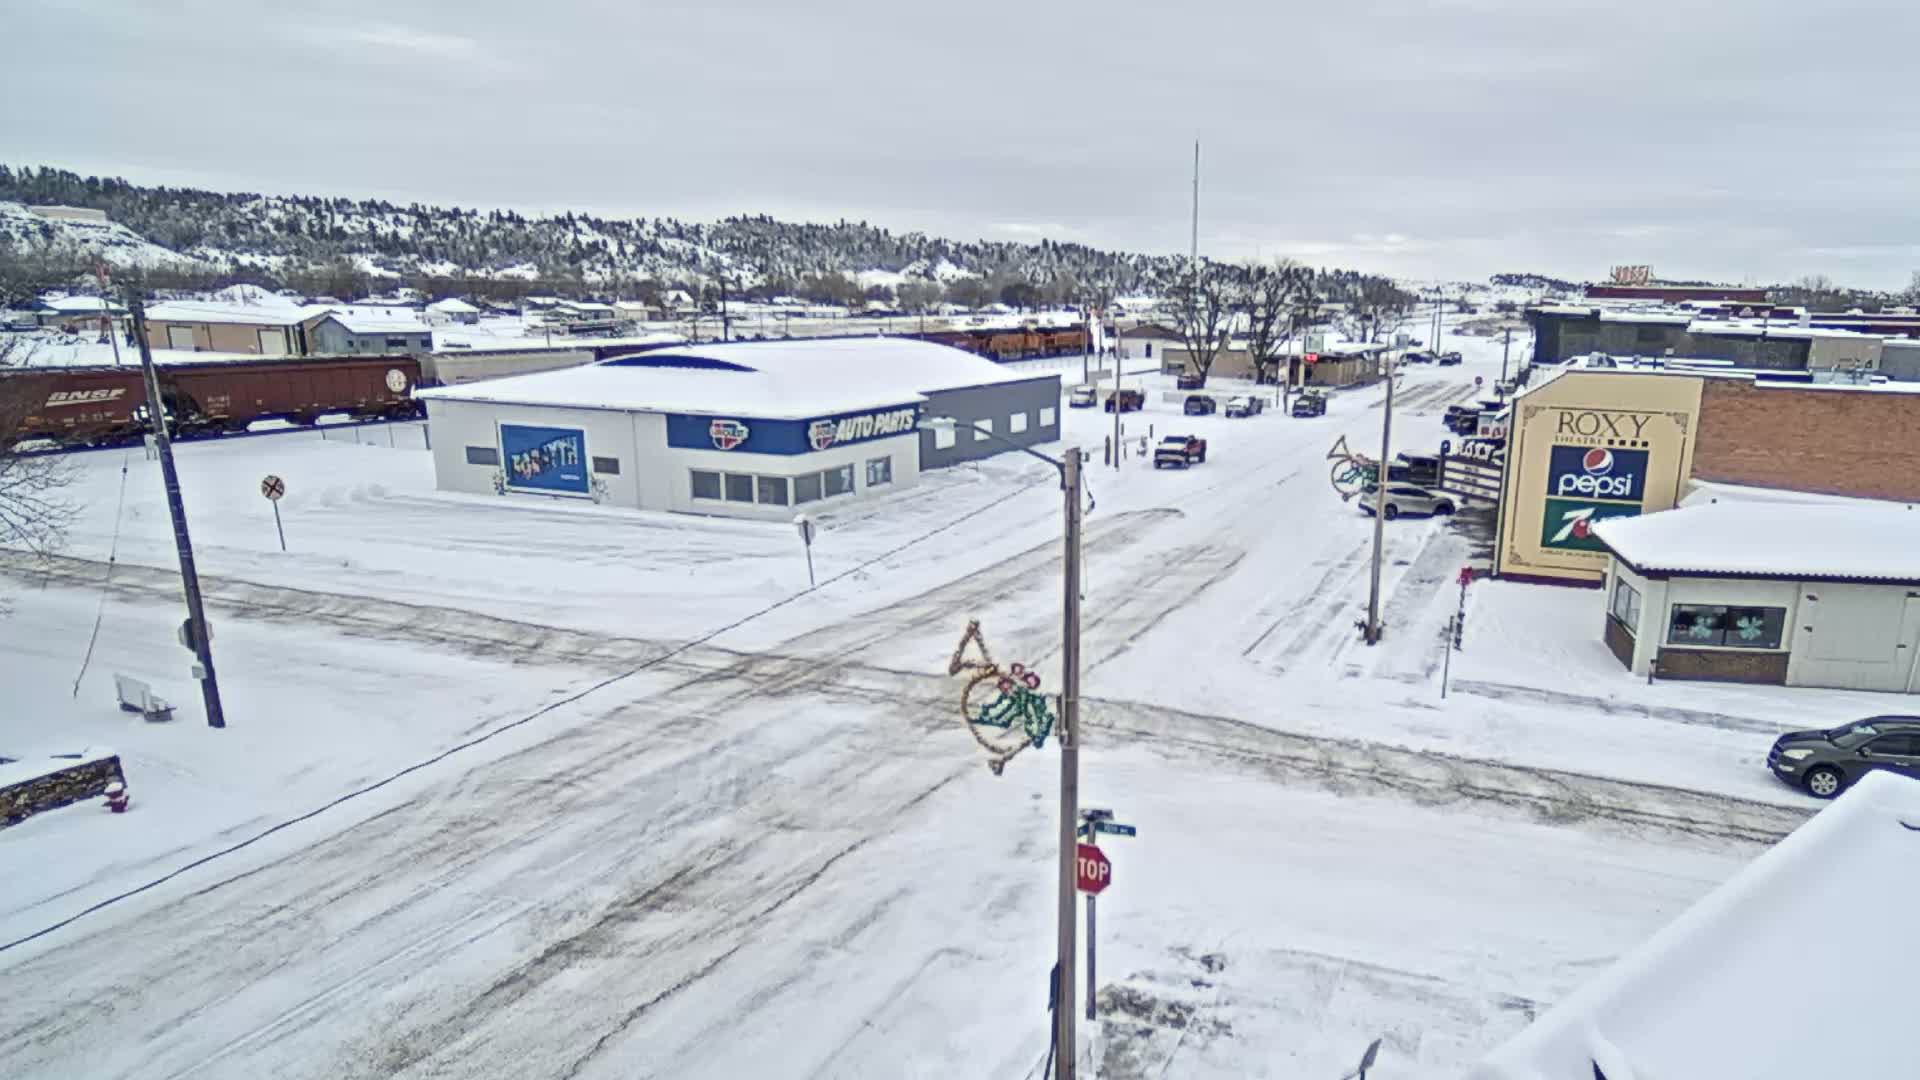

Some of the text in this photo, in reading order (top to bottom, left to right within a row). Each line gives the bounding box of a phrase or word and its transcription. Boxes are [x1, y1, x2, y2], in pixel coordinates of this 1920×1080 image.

[834, 414, 874, 442] AUTO
[874, 408, 915, 435] PARTS
[1557, 411, 1652, 438] ROXY
[1557, 473, 1633, 498] pepsi
[1078, 857, 1109, 882] TOP
